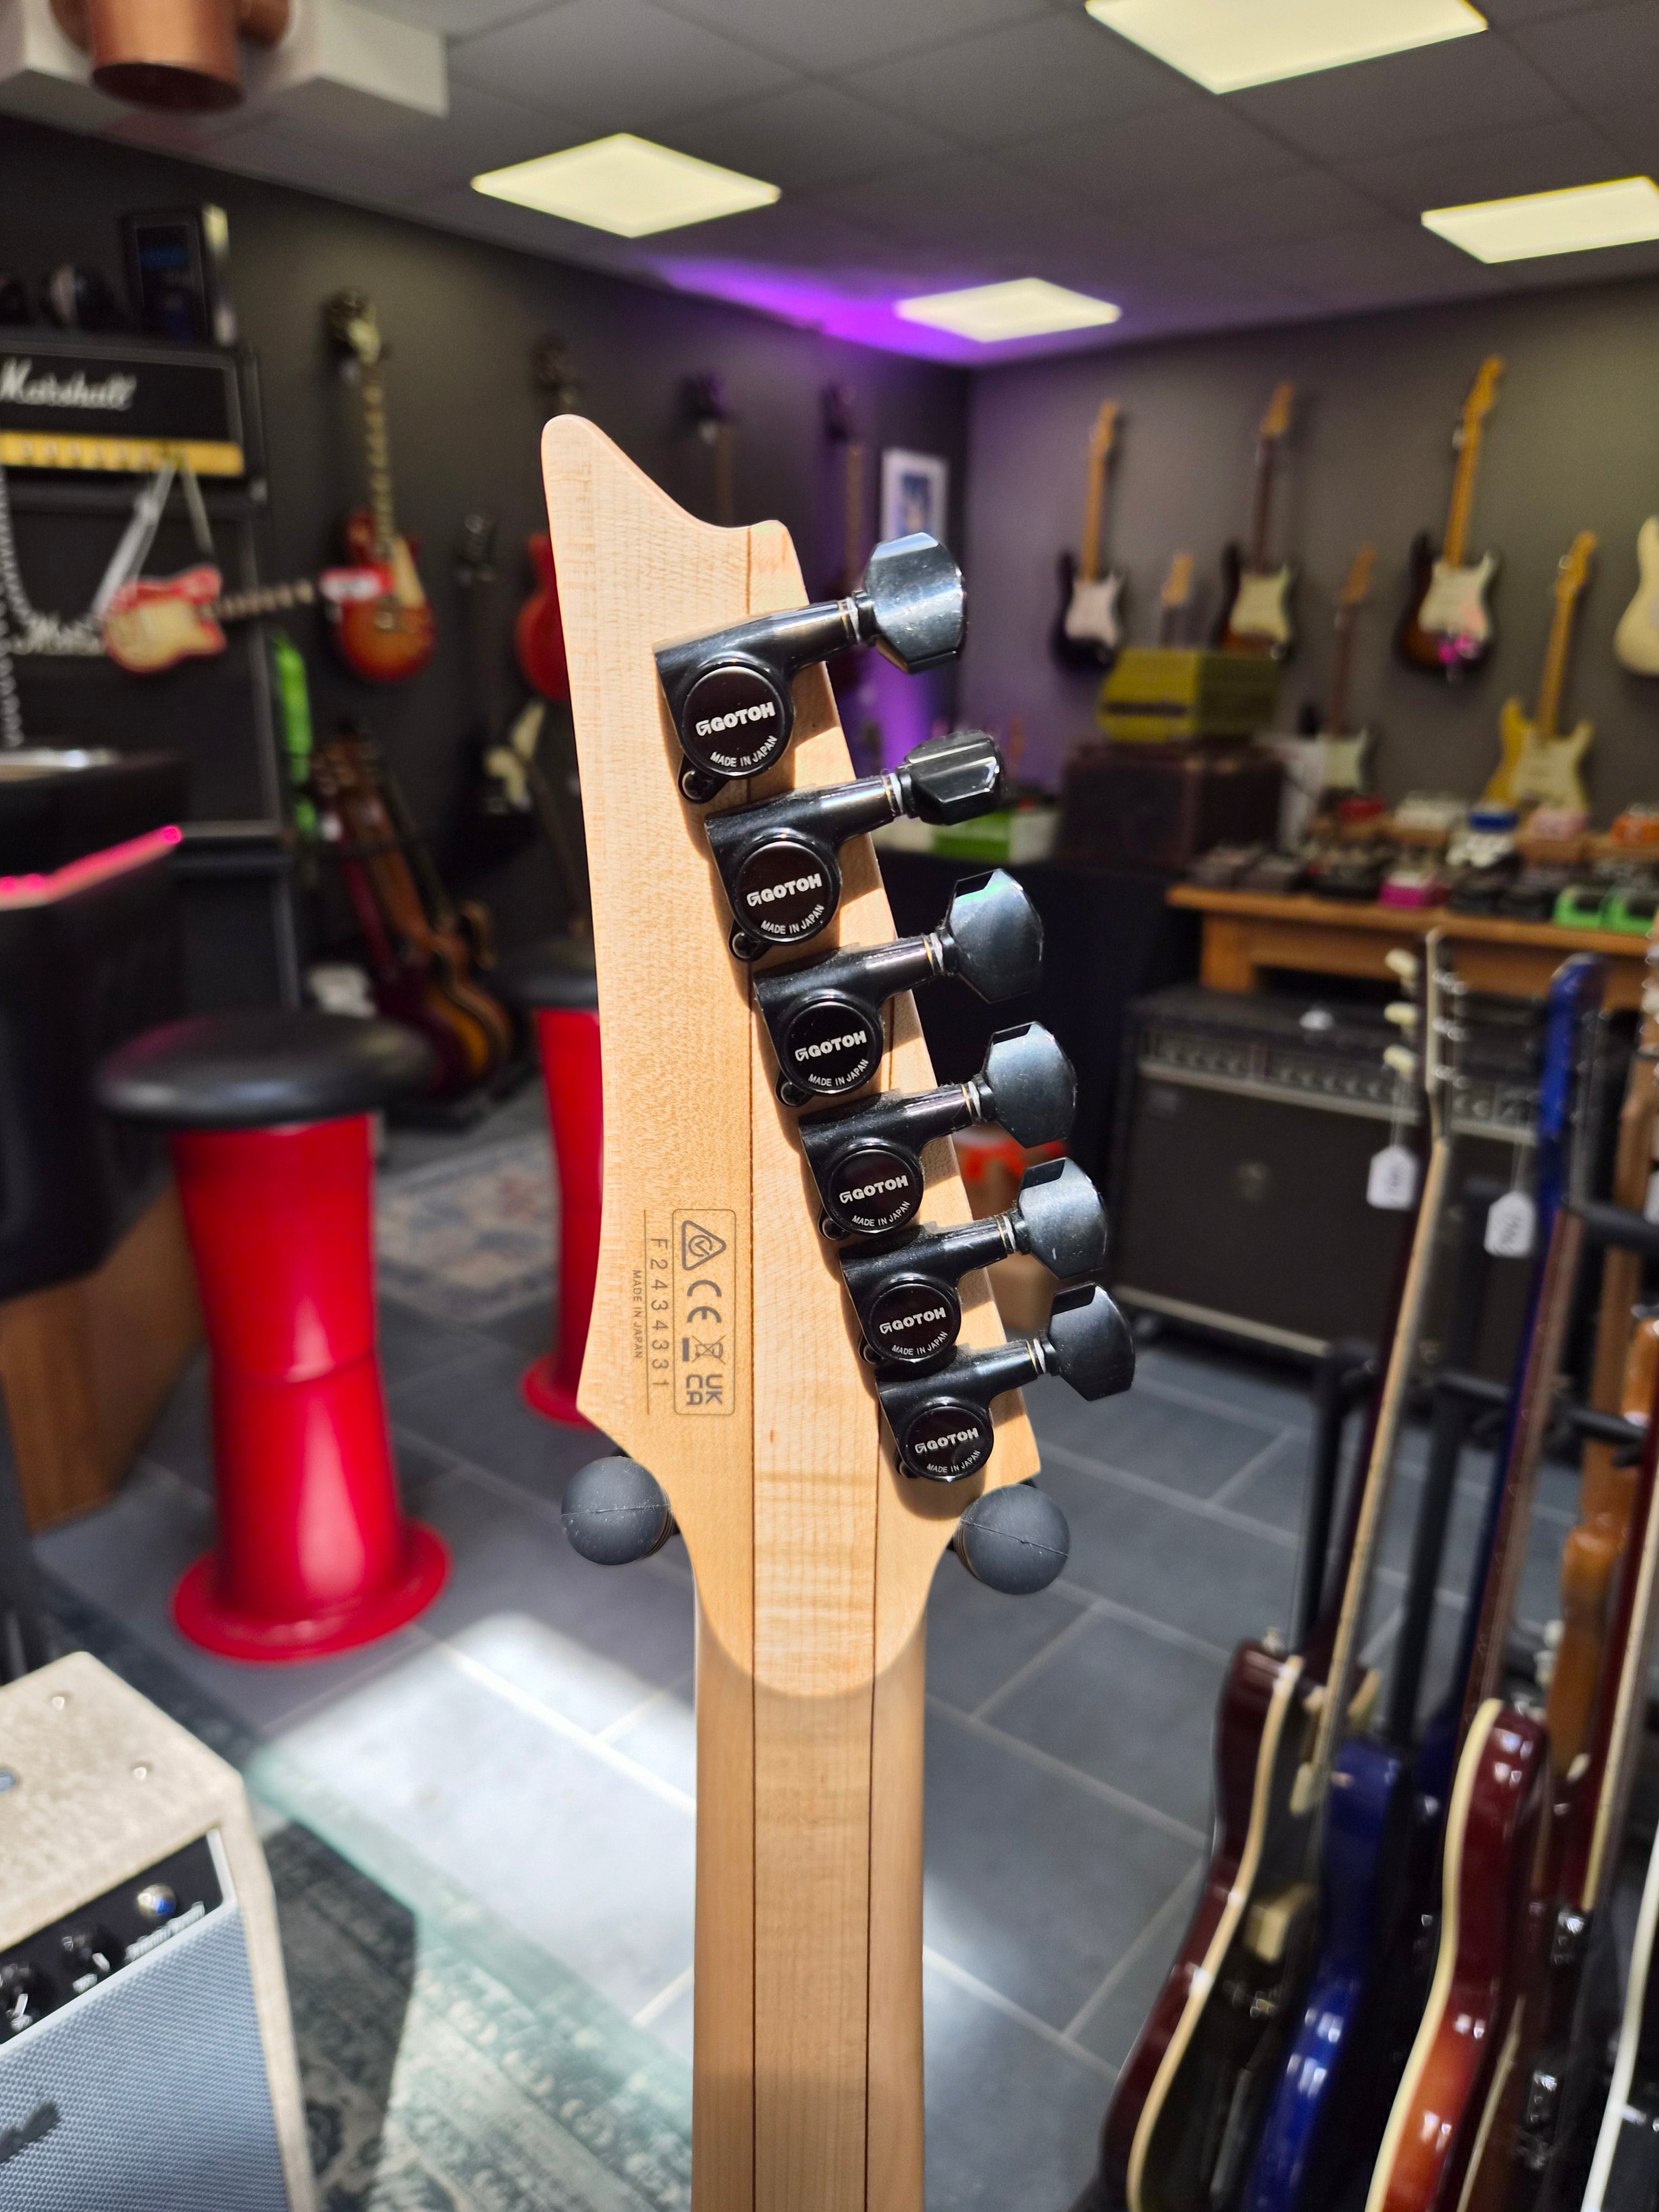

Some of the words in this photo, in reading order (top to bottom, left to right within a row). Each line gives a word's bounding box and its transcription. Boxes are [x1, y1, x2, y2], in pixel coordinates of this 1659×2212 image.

[710, 752, 737, 767] MADE
[740, 757, 751, 766] IN
[752, 735, 778, 763] JAPAN
[761, 920, 786, 934] MADE
[789, 923, 800, 933] IN
[800, 905, 825, 930] JAPAN
[808, 1074, 831, 1087] MADE
[835, 1077, 845, 1086] IN
[846, 1059, 869, 1083] JAPAN
[852, 1215, 874, 1227] MADE
[878, 1218, 888, 1226] IN
[889, 1201, 910, 1223] JAPAN
[632, 1270, 642, 1301] MADE
[634, 1306, 643, 1317] IN
[634, 1320, 643, 1358] JAPAN
[891, 1344, 914, 1355] MADE
[917, 1346, 926, 1354] IN
[926, 1331, 948, 1352] JAPAN
[926, 1464, 947, 1473] MADE
[961, 1450, 980, 1469] JAPAN
